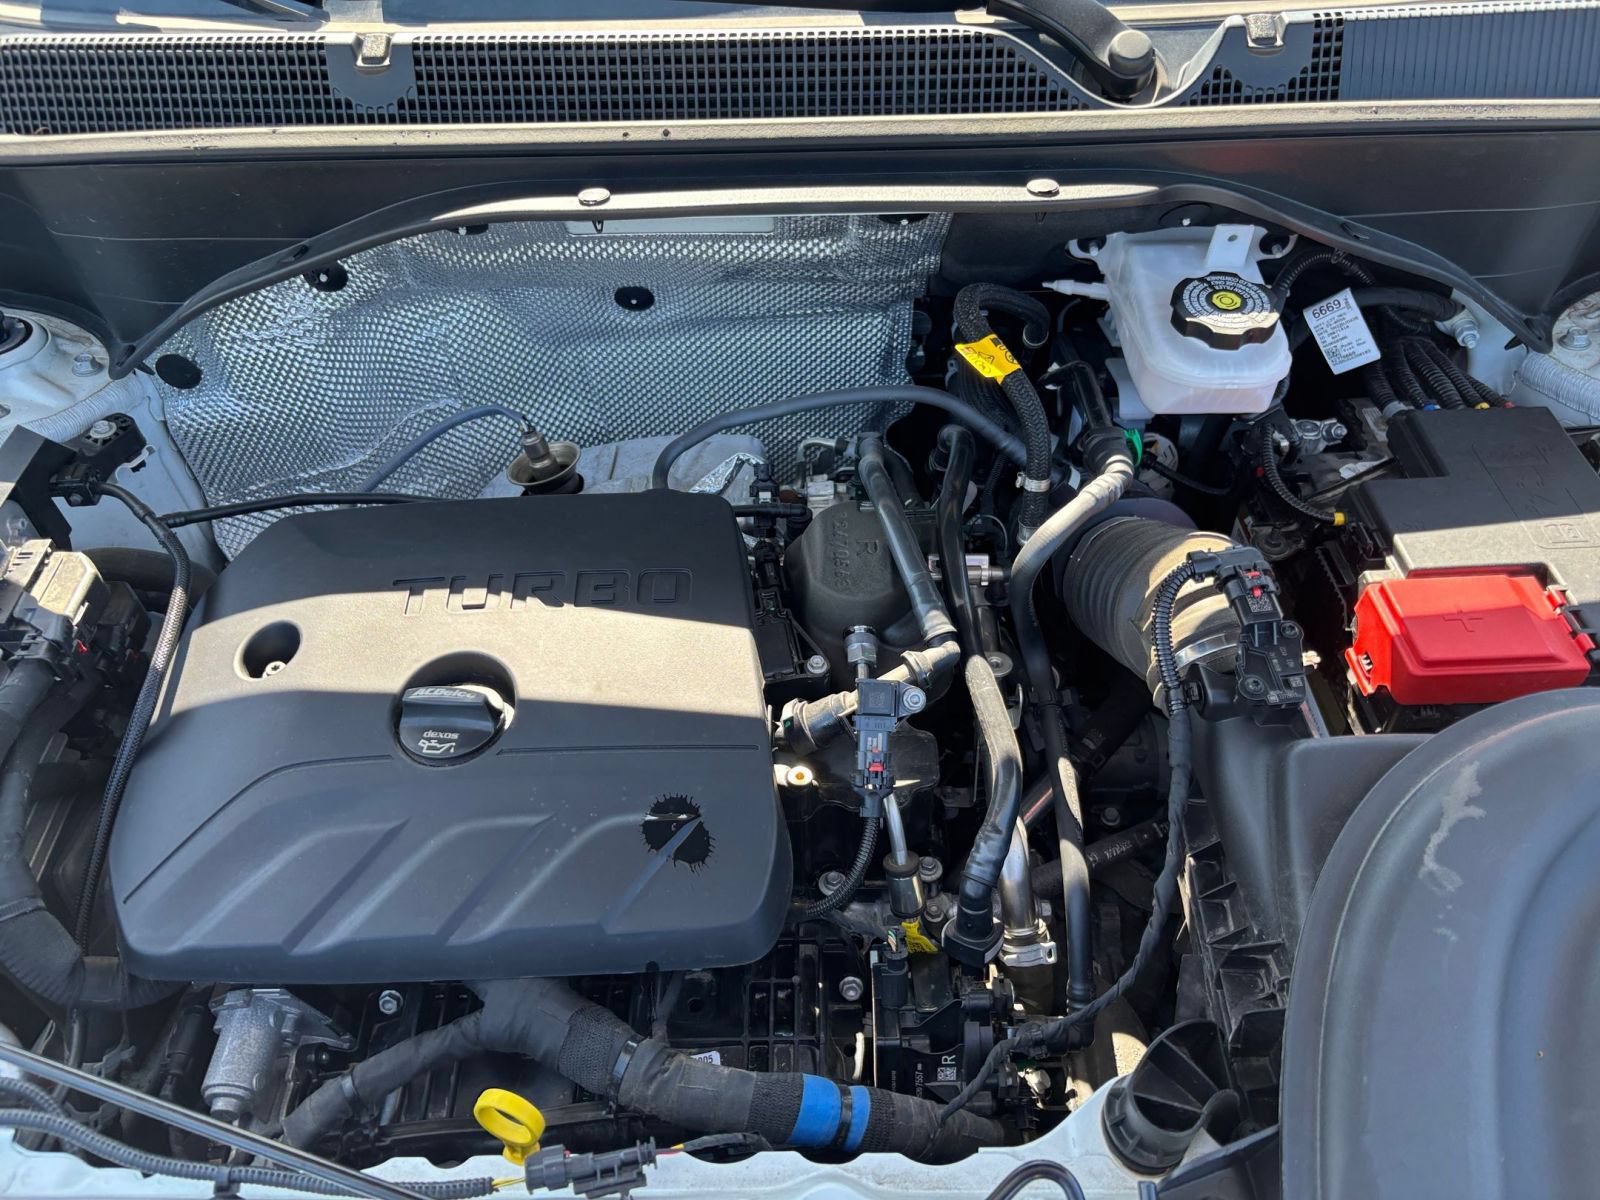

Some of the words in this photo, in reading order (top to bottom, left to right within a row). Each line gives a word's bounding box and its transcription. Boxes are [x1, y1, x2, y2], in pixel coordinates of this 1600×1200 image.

[1312, 299, 1342, 319] 6669
[393, 568, 692, 615] TURBO
[408, 687, 477, 698] ACDelco
[423, 730, 460, 739] dexos
[941, 1055, 956, 1064] R
